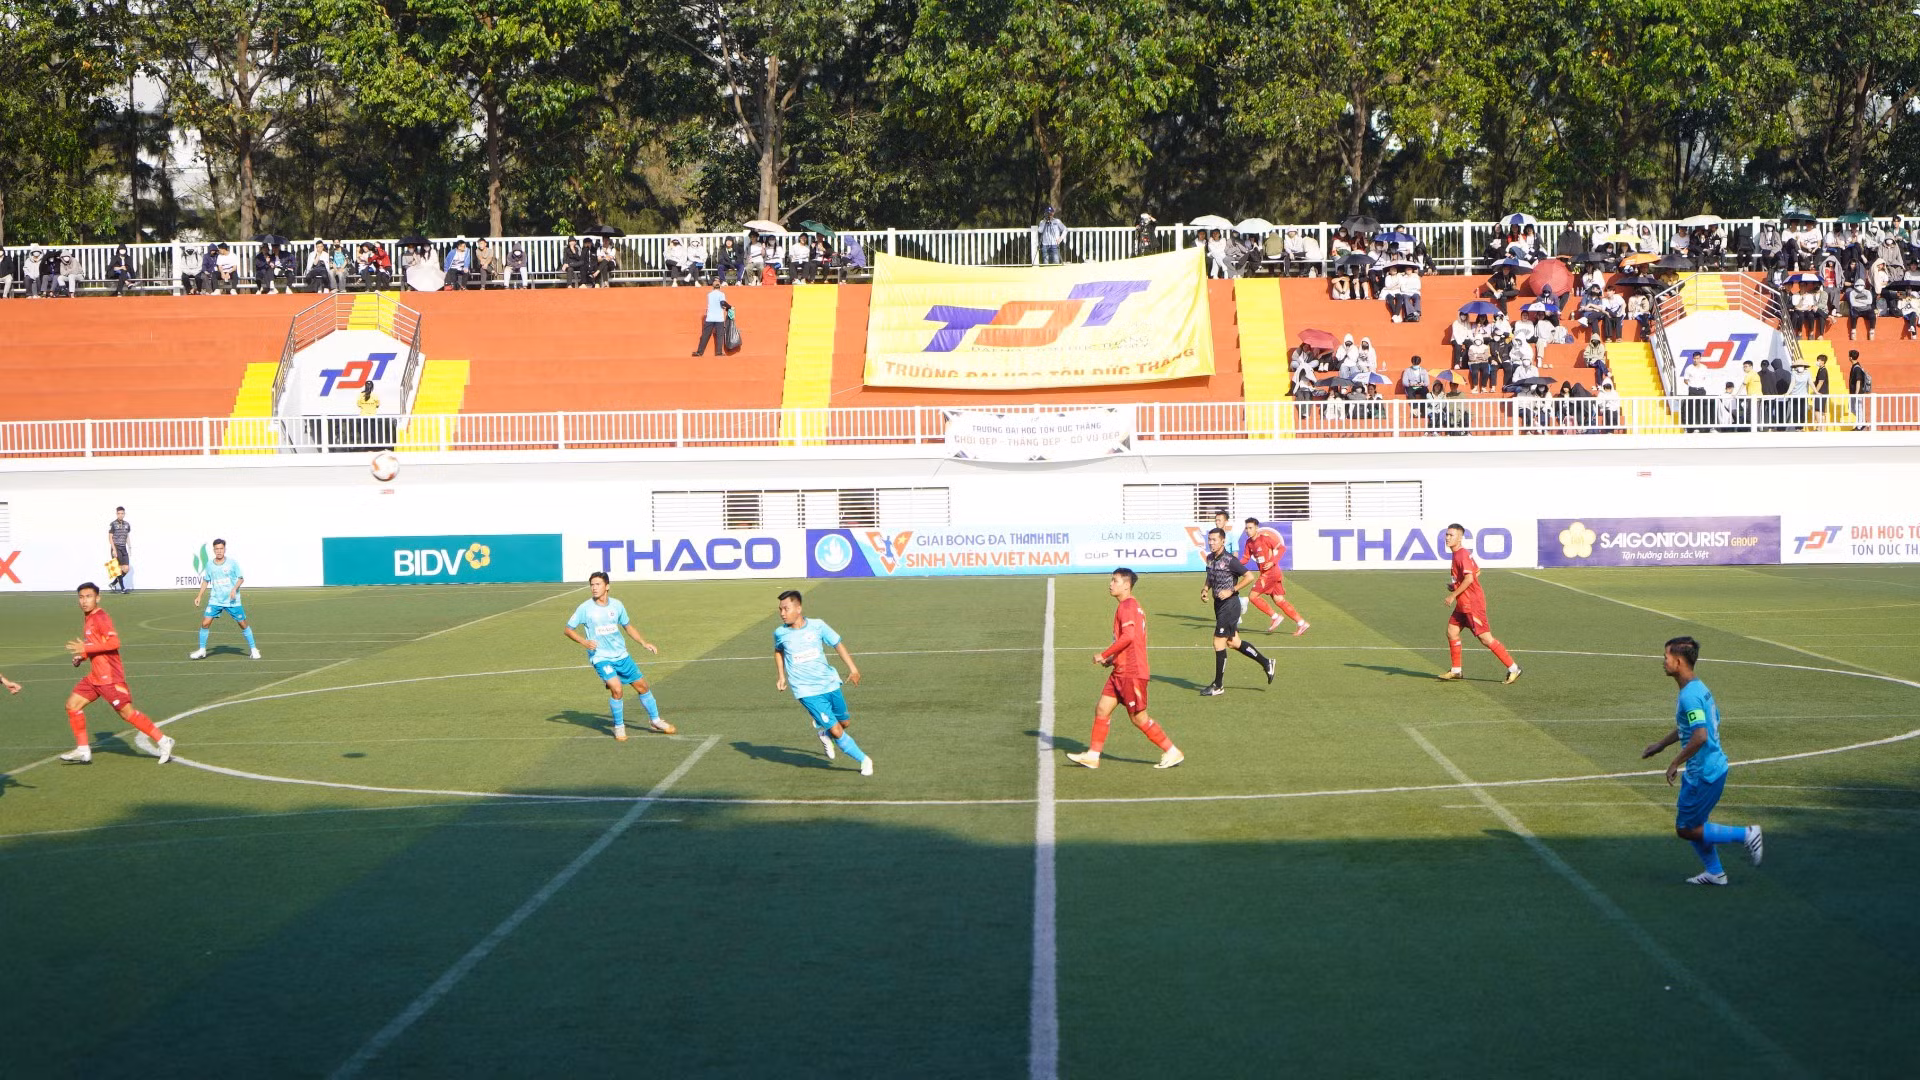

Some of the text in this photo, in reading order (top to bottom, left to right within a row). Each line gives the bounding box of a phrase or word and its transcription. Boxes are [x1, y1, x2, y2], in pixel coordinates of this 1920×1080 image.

[319, 353, 397, 396] TDT
[1137, 531, 1162, 540] 2025
[1600, 531, 1758, 548] SAIGONTOURIST GROUP
[1851, 526, 1873, 542] ĐẠI
[1877, 526, 1904, 542] HỌC
[1319, 528, 1513, 561] THACO
[588, 537, 781, 572] THACO
[906, 552, 945, 567] SINH
[1028, 551, 1070, 566] NAM
[1113, 548, 1178, 558] THACO
[395, 548, 465, 576] BIDV
[1689, 712, 1697, 721] C
